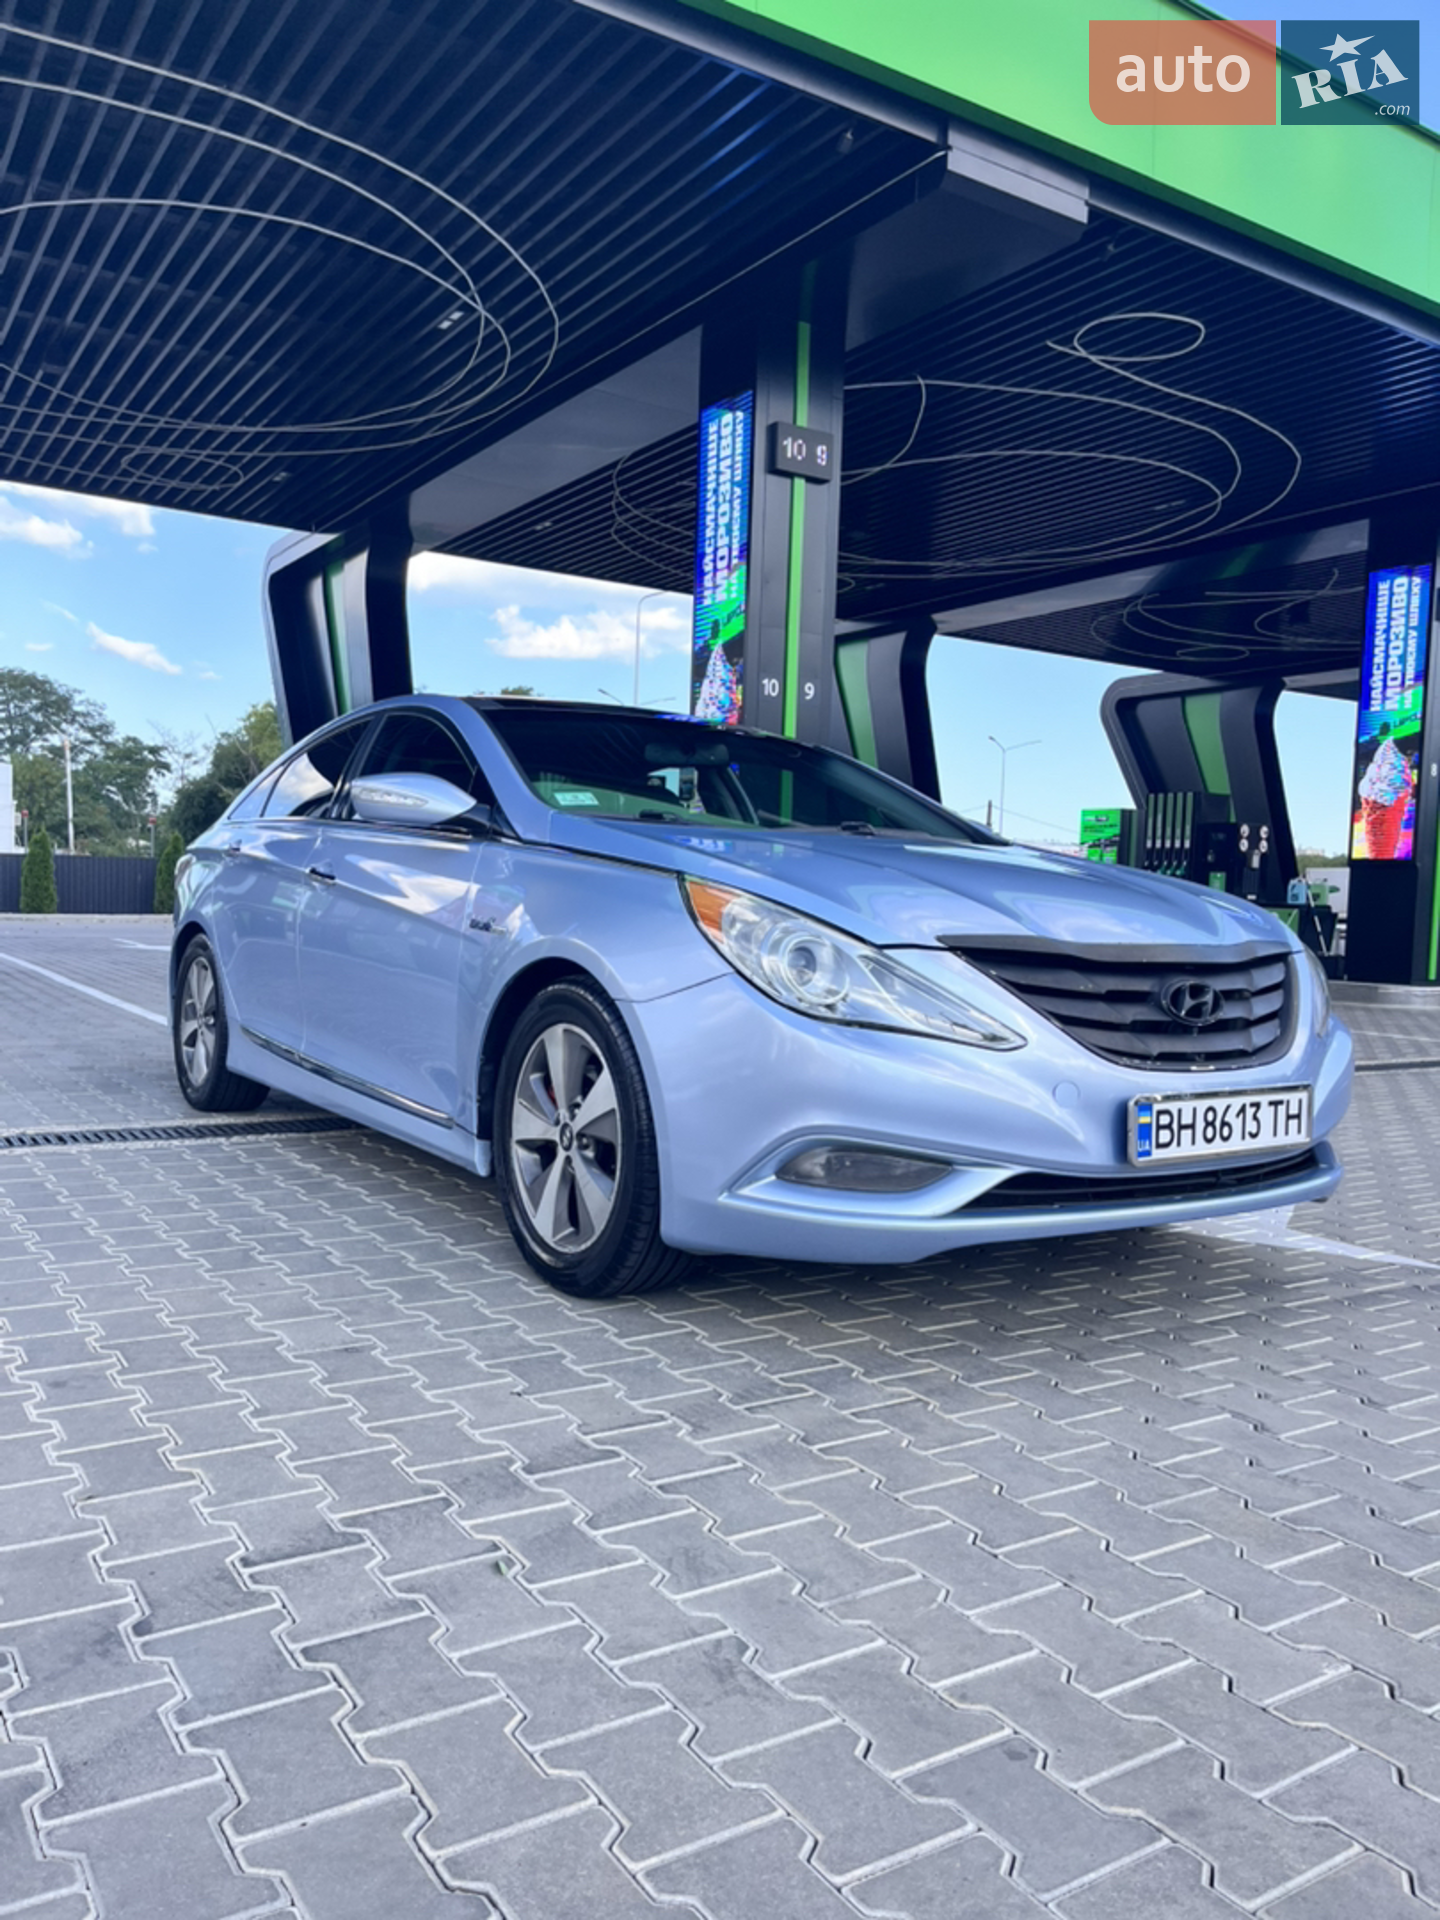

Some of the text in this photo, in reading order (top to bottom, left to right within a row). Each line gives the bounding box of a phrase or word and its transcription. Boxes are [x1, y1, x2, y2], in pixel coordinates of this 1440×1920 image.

[783, 437, 828, 466] 10 9
[716, 412, 733, 602] МОРОЗИВО
[730, 570, 739, 598] НА
[1369, 579, 1390, 711] НАЙСМАЧНІШЕ
[1385, 576, 1409, 710] МОРОЗИВО
[1404, 689, 1413, 709] НА
[1409, 576, 1421, 627] ШЛЯХУ
[762, 678, 815, 700] 10 9
[1137, 1139, 1150, 1151] UA
[1155, 1098, 1302, 1149] BH 8613 TH
